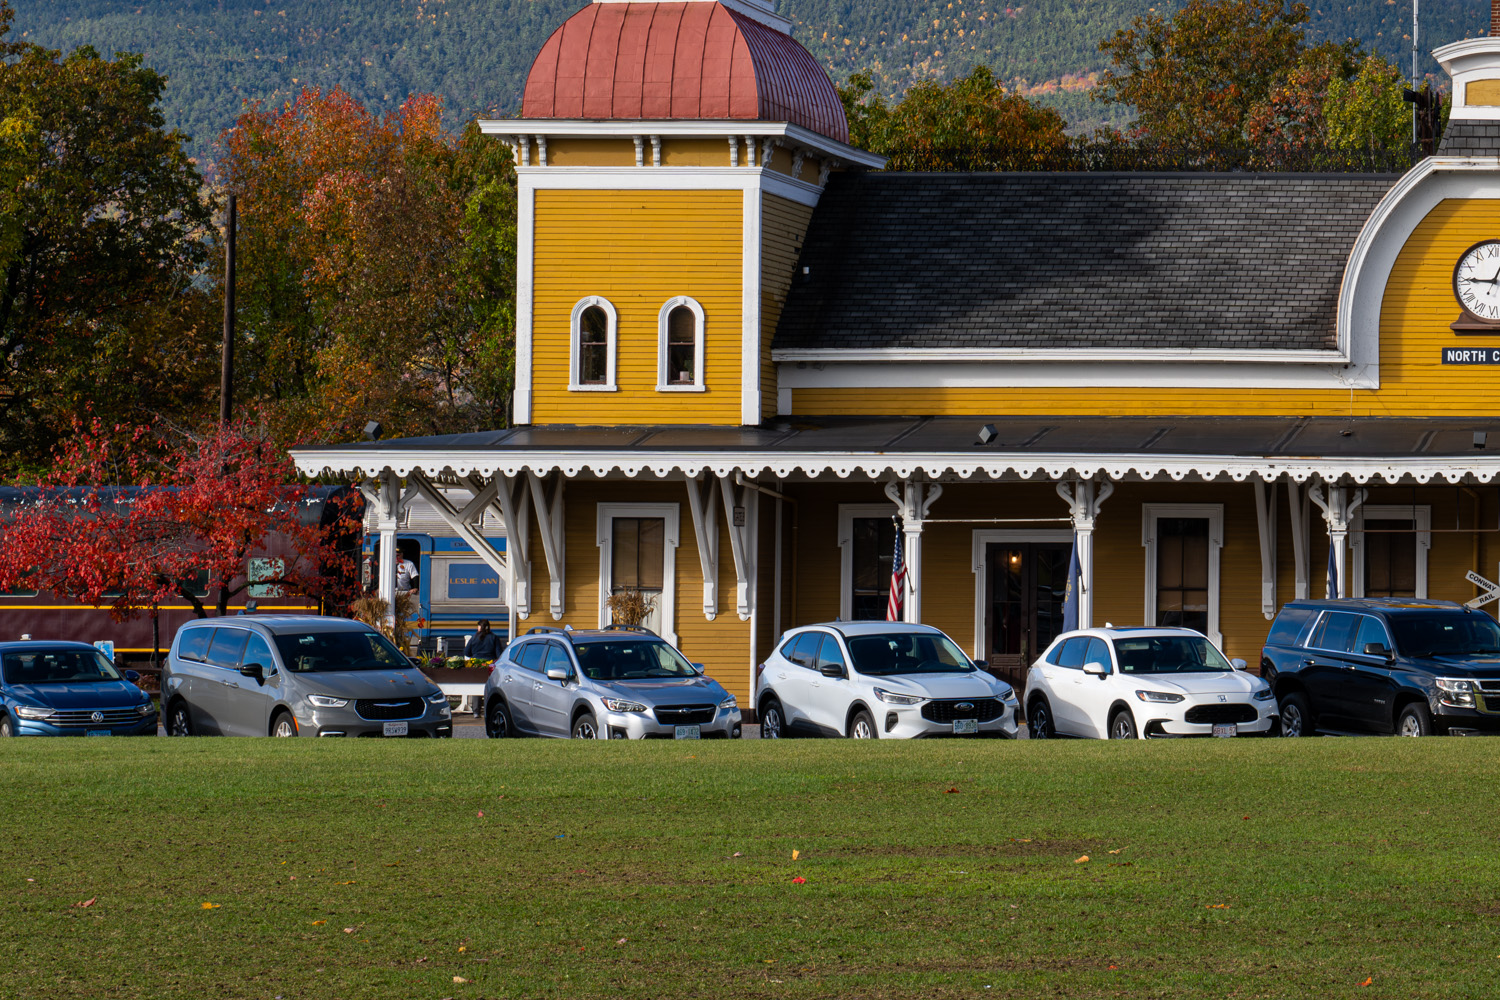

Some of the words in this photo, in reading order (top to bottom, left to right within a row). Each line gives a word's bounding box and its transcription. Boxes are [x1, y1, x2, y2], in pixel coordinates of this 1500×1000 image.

[1447, 350, 1486, 362] NORTH
[1469, 573, 1497, 592] CONWAY
[1478, 593, 1496, 604] RAIL
